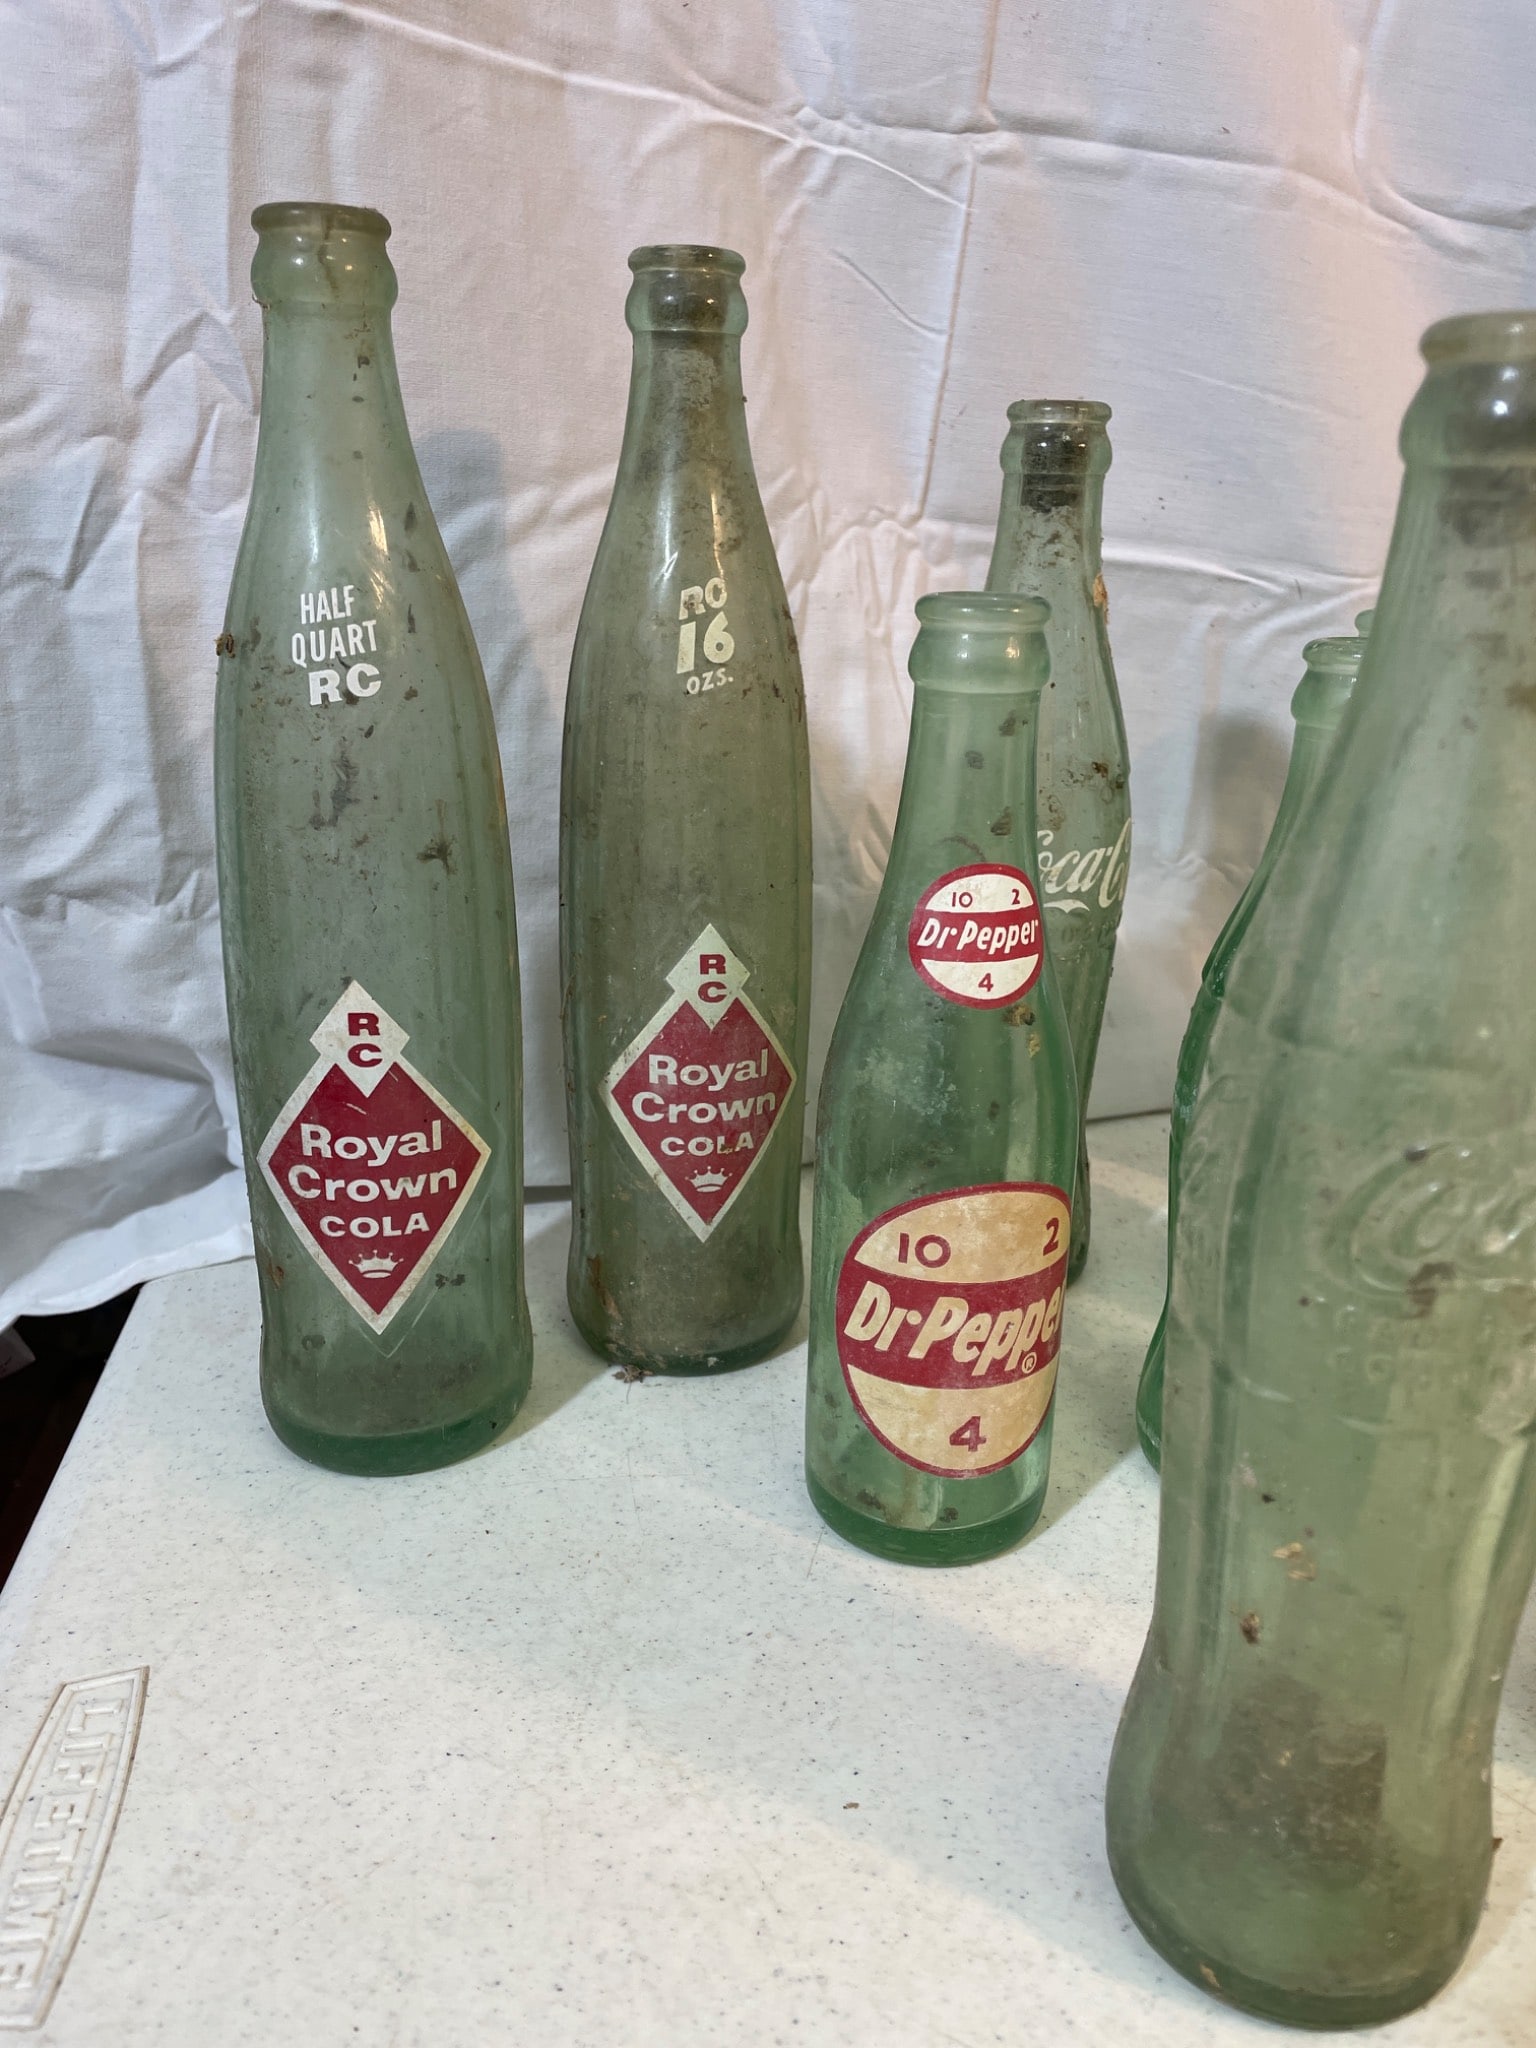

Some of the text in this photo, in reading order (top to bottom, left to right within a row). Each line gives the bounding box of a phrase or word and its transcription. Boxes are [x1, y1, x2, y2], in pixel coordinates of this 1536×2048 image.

[300, 585, 355, 625] HALF
[291, 619, 377, 668] QUART
[676, 611, 735, 674] 16
[308, 663, 382, 706] RC
[686, 668, 733, 694] OZS.
[951, 888, 1021, 908] 10 2
[978, 973, 994, 992] 4
[648, 1048, 769, 1092] Royal
[631, 1091, 776, 1125] Crown
[300, 1119, 443, 1167] Royal
[660, 1138, 754, 1157] COLA
[288, 1164, 458, 1203] Crown
[319, 1212, 430, 1239] COLA
[898, 1217, 1059, 1269] 10 2
[949, 1415, 987, 1452] 4
